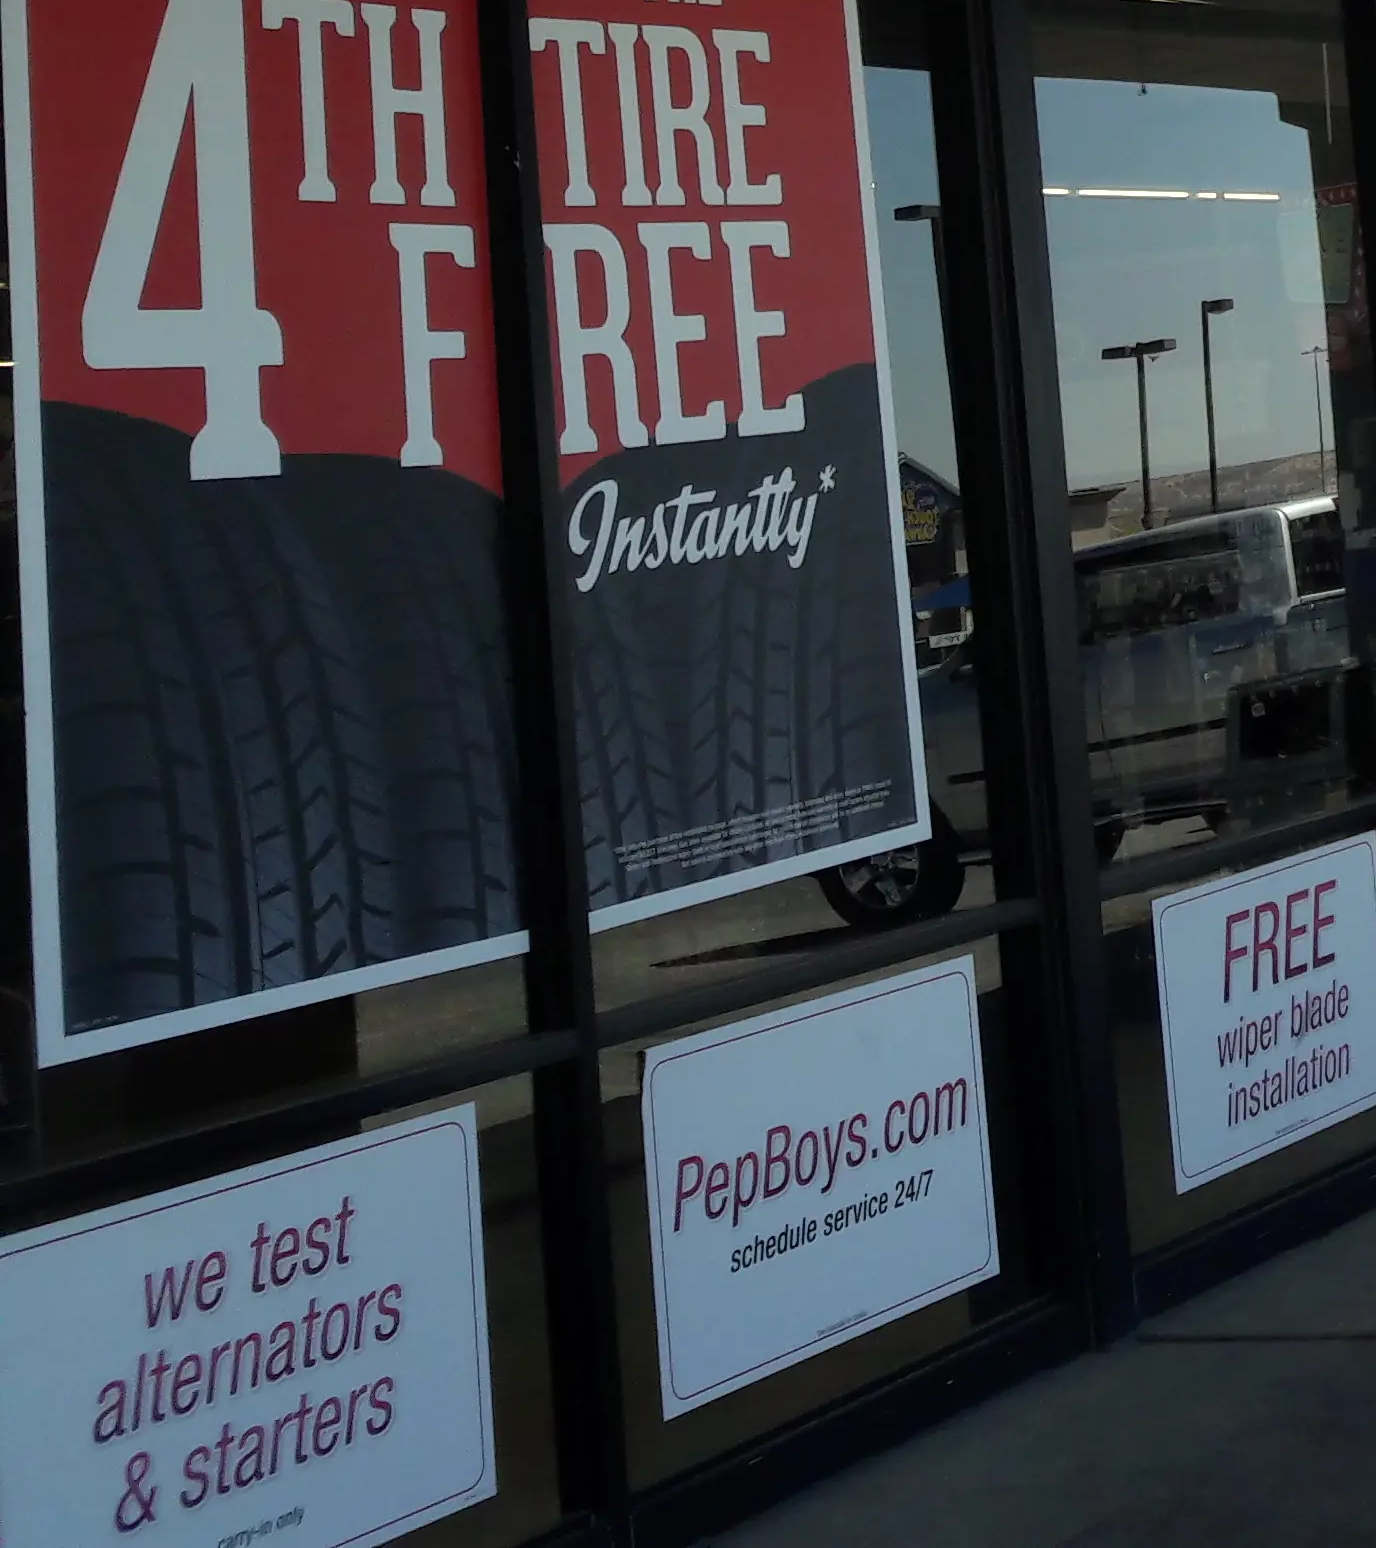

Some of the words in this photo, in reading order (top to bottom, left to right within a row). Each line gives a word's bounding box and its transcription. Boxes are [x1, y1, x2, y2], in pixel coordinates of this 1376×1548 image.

[528, 17, 783, 208] TIRE
[1223, 878, 1338, 1004] FREE
[1217, 1009, 1283, 1068] wiper
[1291, 979, 1350, 1039] blade
[1228, 1042, 1352, 1127] installation
[673, 1077, 968, 1233] PepBoys.com
[144, 1250, 227, 1329] we
[250, 1195, 356, 1293] test
[730, 1217, 817, 1273] schedule
[823, 1190, 888, 1236] service
[894, 1168, 934, 1209] 24/7
[93, 1282, 403, 1444] alternators
[115, 1451, 158, 1533] &
[179, 1375, 395, 1509] starters
[217, 1519, 273, 1548] carry-in
[276, 1505, 305, 1530] only
